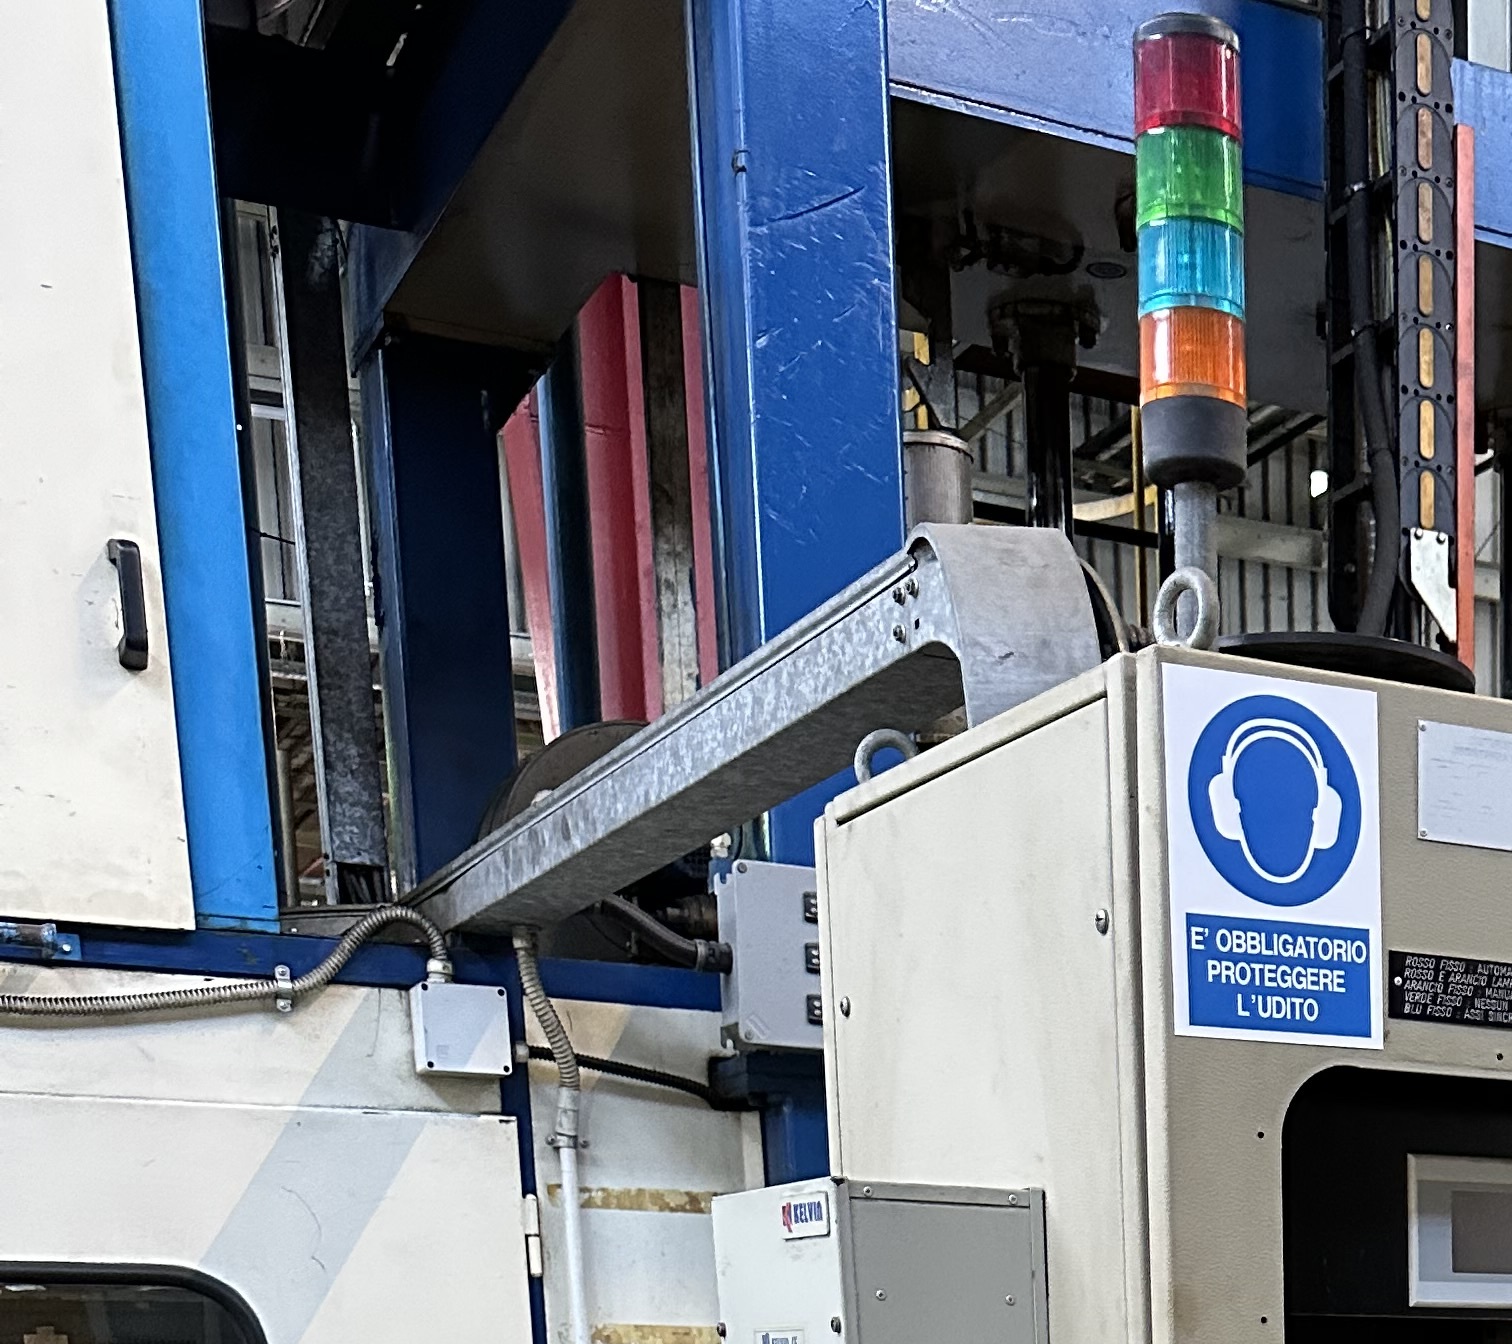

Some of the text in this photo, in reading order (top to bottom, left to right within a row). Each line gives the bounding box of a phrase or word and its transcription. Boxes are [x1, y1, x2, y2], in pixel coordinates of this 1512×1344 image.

[1191, 926, 1367, 964] E' OBBLIGATORIO
[1405, 955, 1436, 969] ROSSO
[1440, 959, 1466, 973] FISSO
[1207, 958, 1346, 993] PROTEGGERE
[1404, 968, 1434, 981] ROSSO
[1438, 970, 1446, 982] E
[1448, 972, 1488, 986] ARANCIO
[1404, 980, 1443, 994] ARANCIO
[1448, 984, 1474, 997] FISSO
[1237, 993, 1319, 1022] L'UDITO
[1404, 990, 1434, 1004] VERDE
[1437, 994, 1463, 1007] FISSO
[1474, 997, 1509, 1012] NESSUN
[1403, 1002, 1422, 1015] BLU
[1427, 1005, 1453, 1018] FISSO
[1464, 1007, 1485, 1021] ASSI
